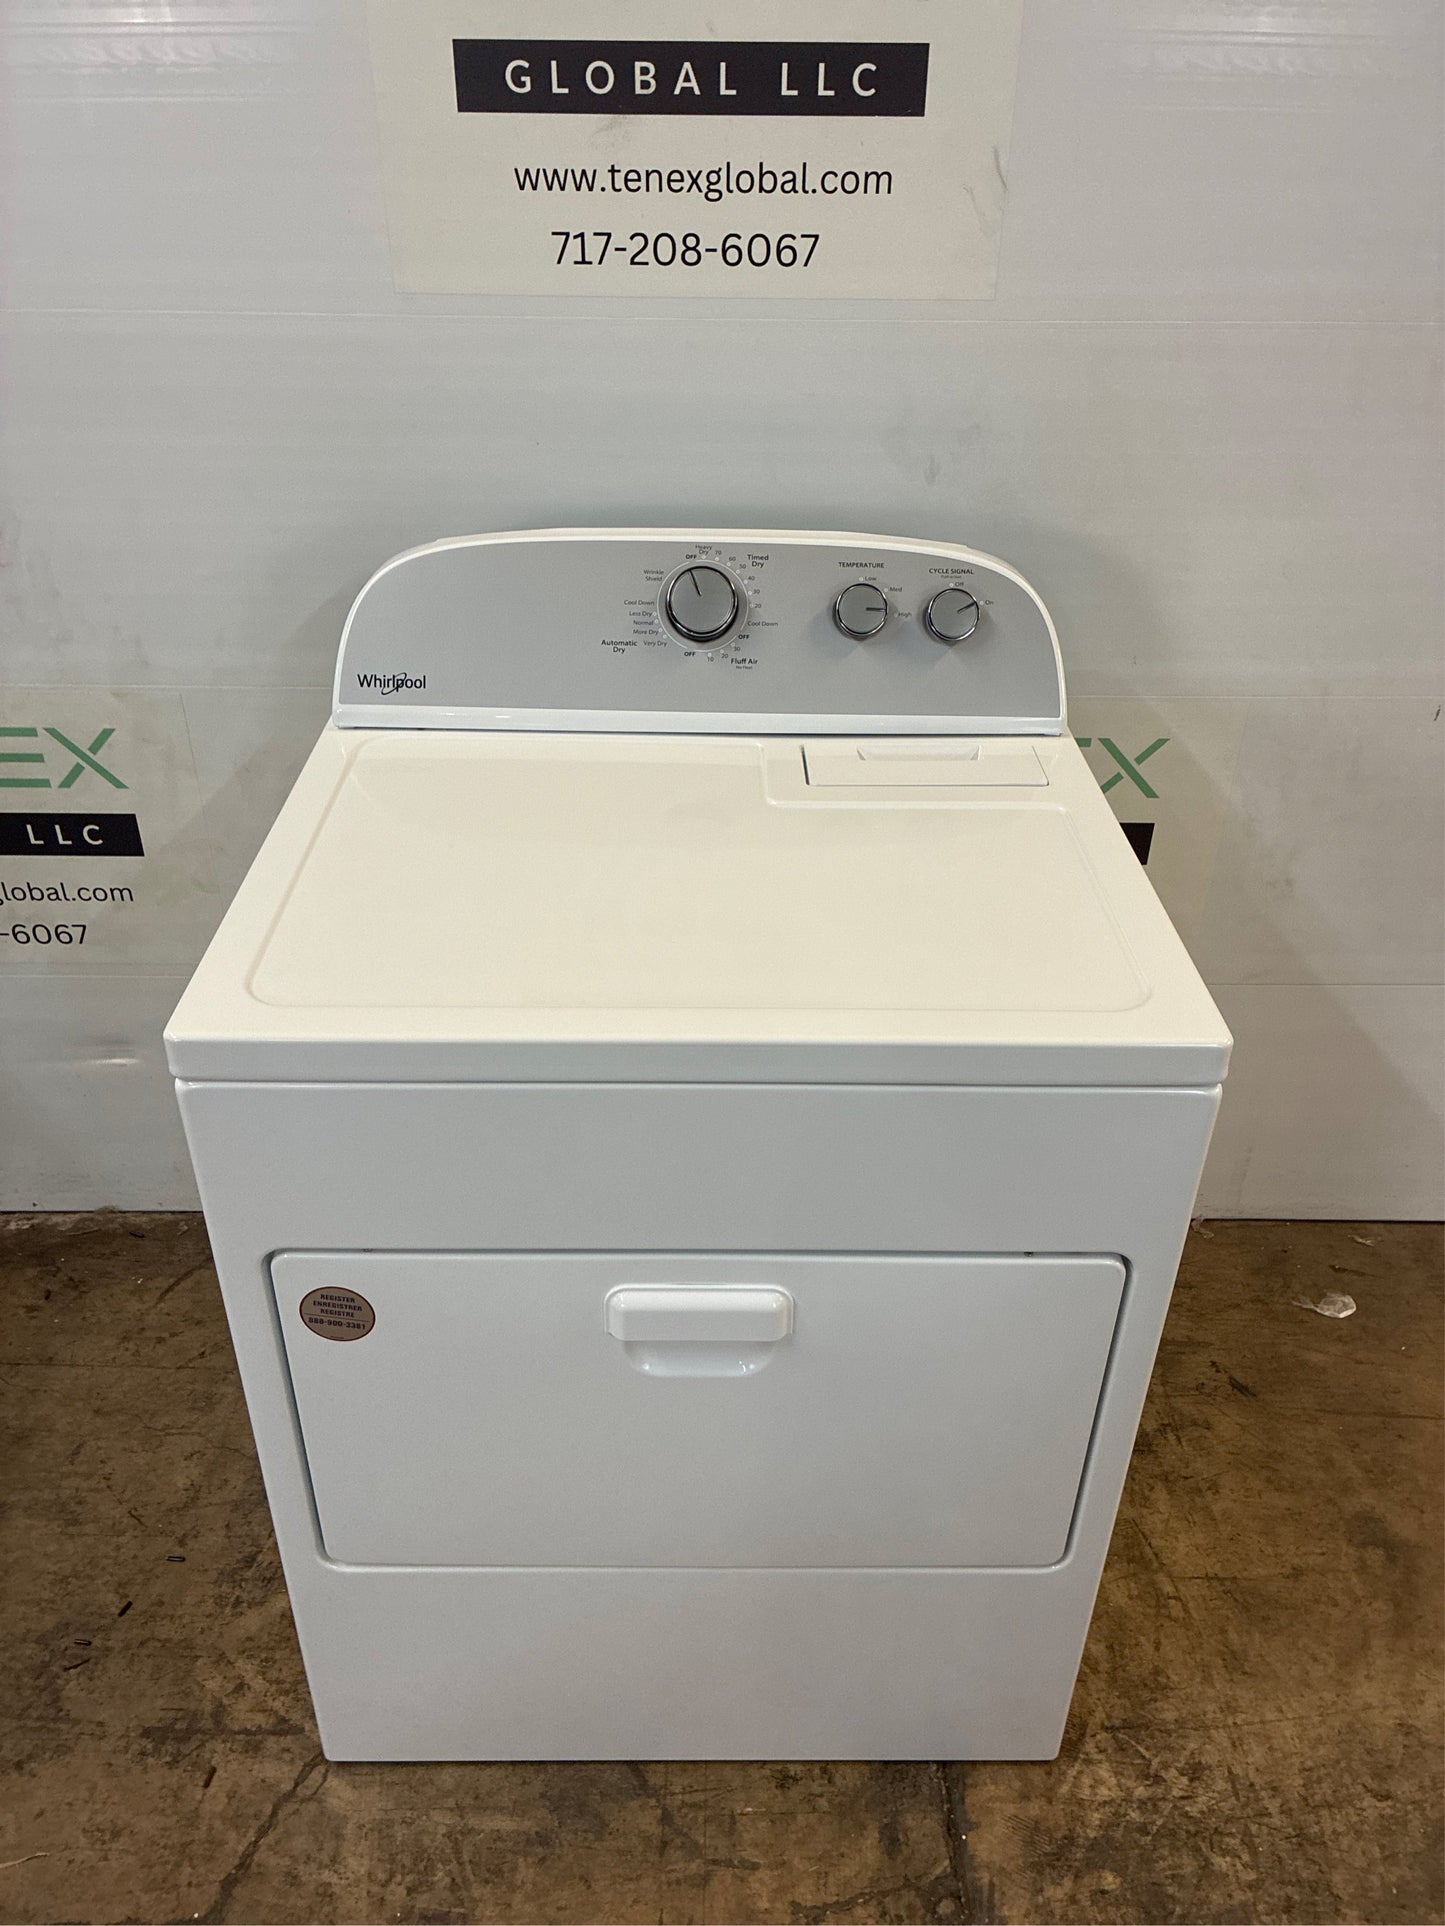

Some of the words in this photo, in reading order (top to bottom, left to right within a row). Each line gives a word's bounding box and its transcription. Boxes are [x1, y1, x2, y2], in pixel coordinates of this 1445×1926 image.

[504, 58, 737, 97] GLOBAL
[780, 61, 880, 98] LLC
[513, 161, 894, 202] www.tenexglobal.com
[550, 230, 821, 269] 717-208-6067
[751, 560, 765, 569] Dry
[838, 561, 885, 569] TEMPERATURE
[601, 639, 638, 647] Automatic
[612, 646, 626, 654] Dry
[730, 657, 746, 665] Fluff
[357, 672, 427, 696] Whirlpool
[26, 823, 104, 846] LLC
[0, 881, 135, 906] lobal.com
[320, 1294, 355, 1303] REGISTER
